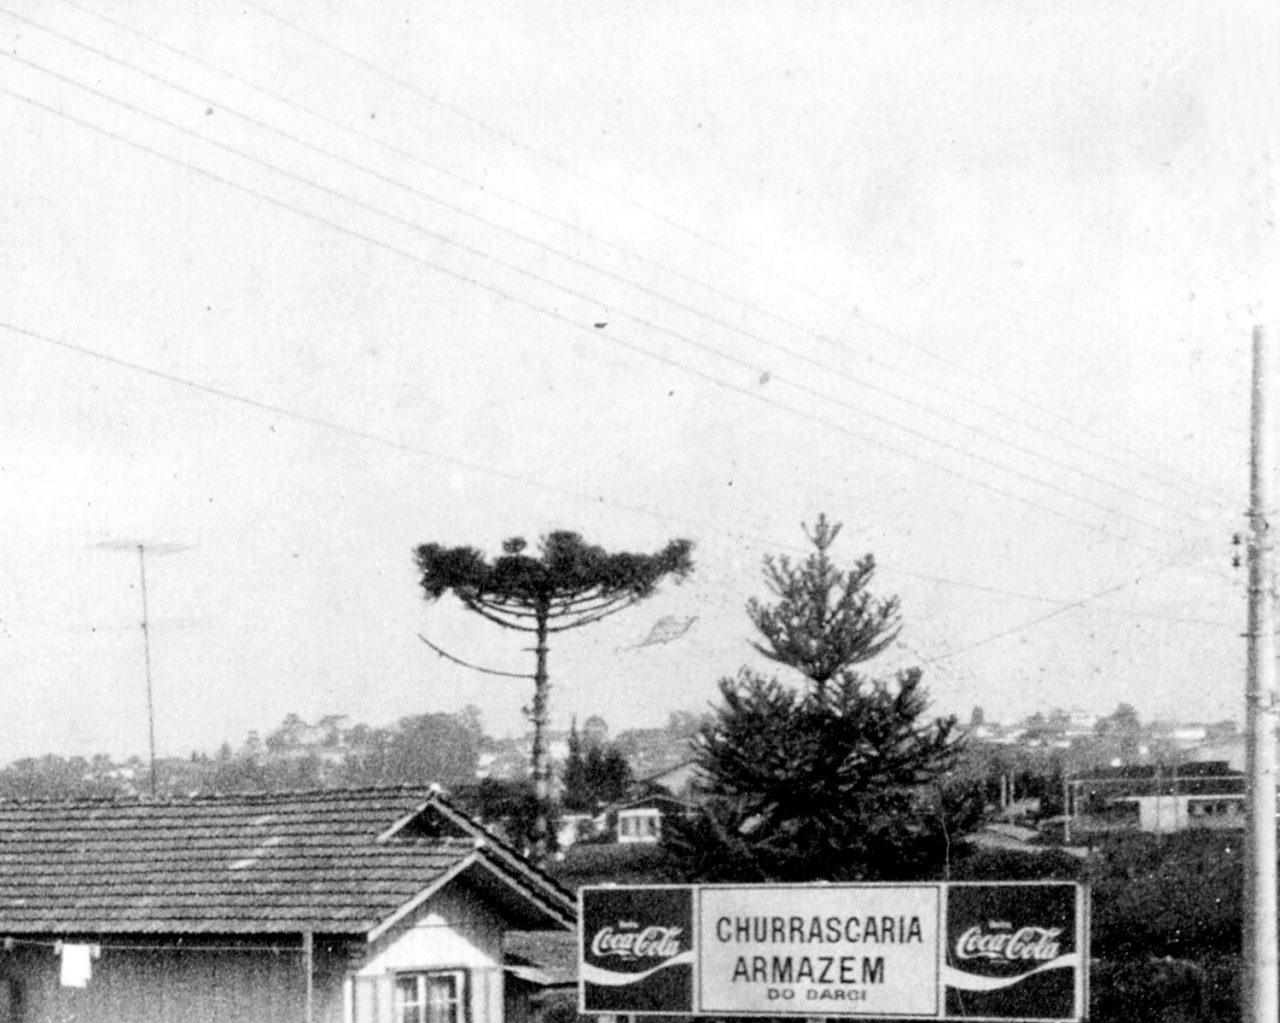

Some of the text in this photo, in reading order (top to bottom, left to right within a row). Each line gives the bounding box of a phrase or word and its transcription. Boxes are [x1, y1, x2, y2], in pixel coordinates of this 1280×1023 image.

[716, 916, 923, 944] CHURRASCARIA
[732, 955, 886, 984] ARMAZEM
[767, 988, 867, 1001] DO DARCI
